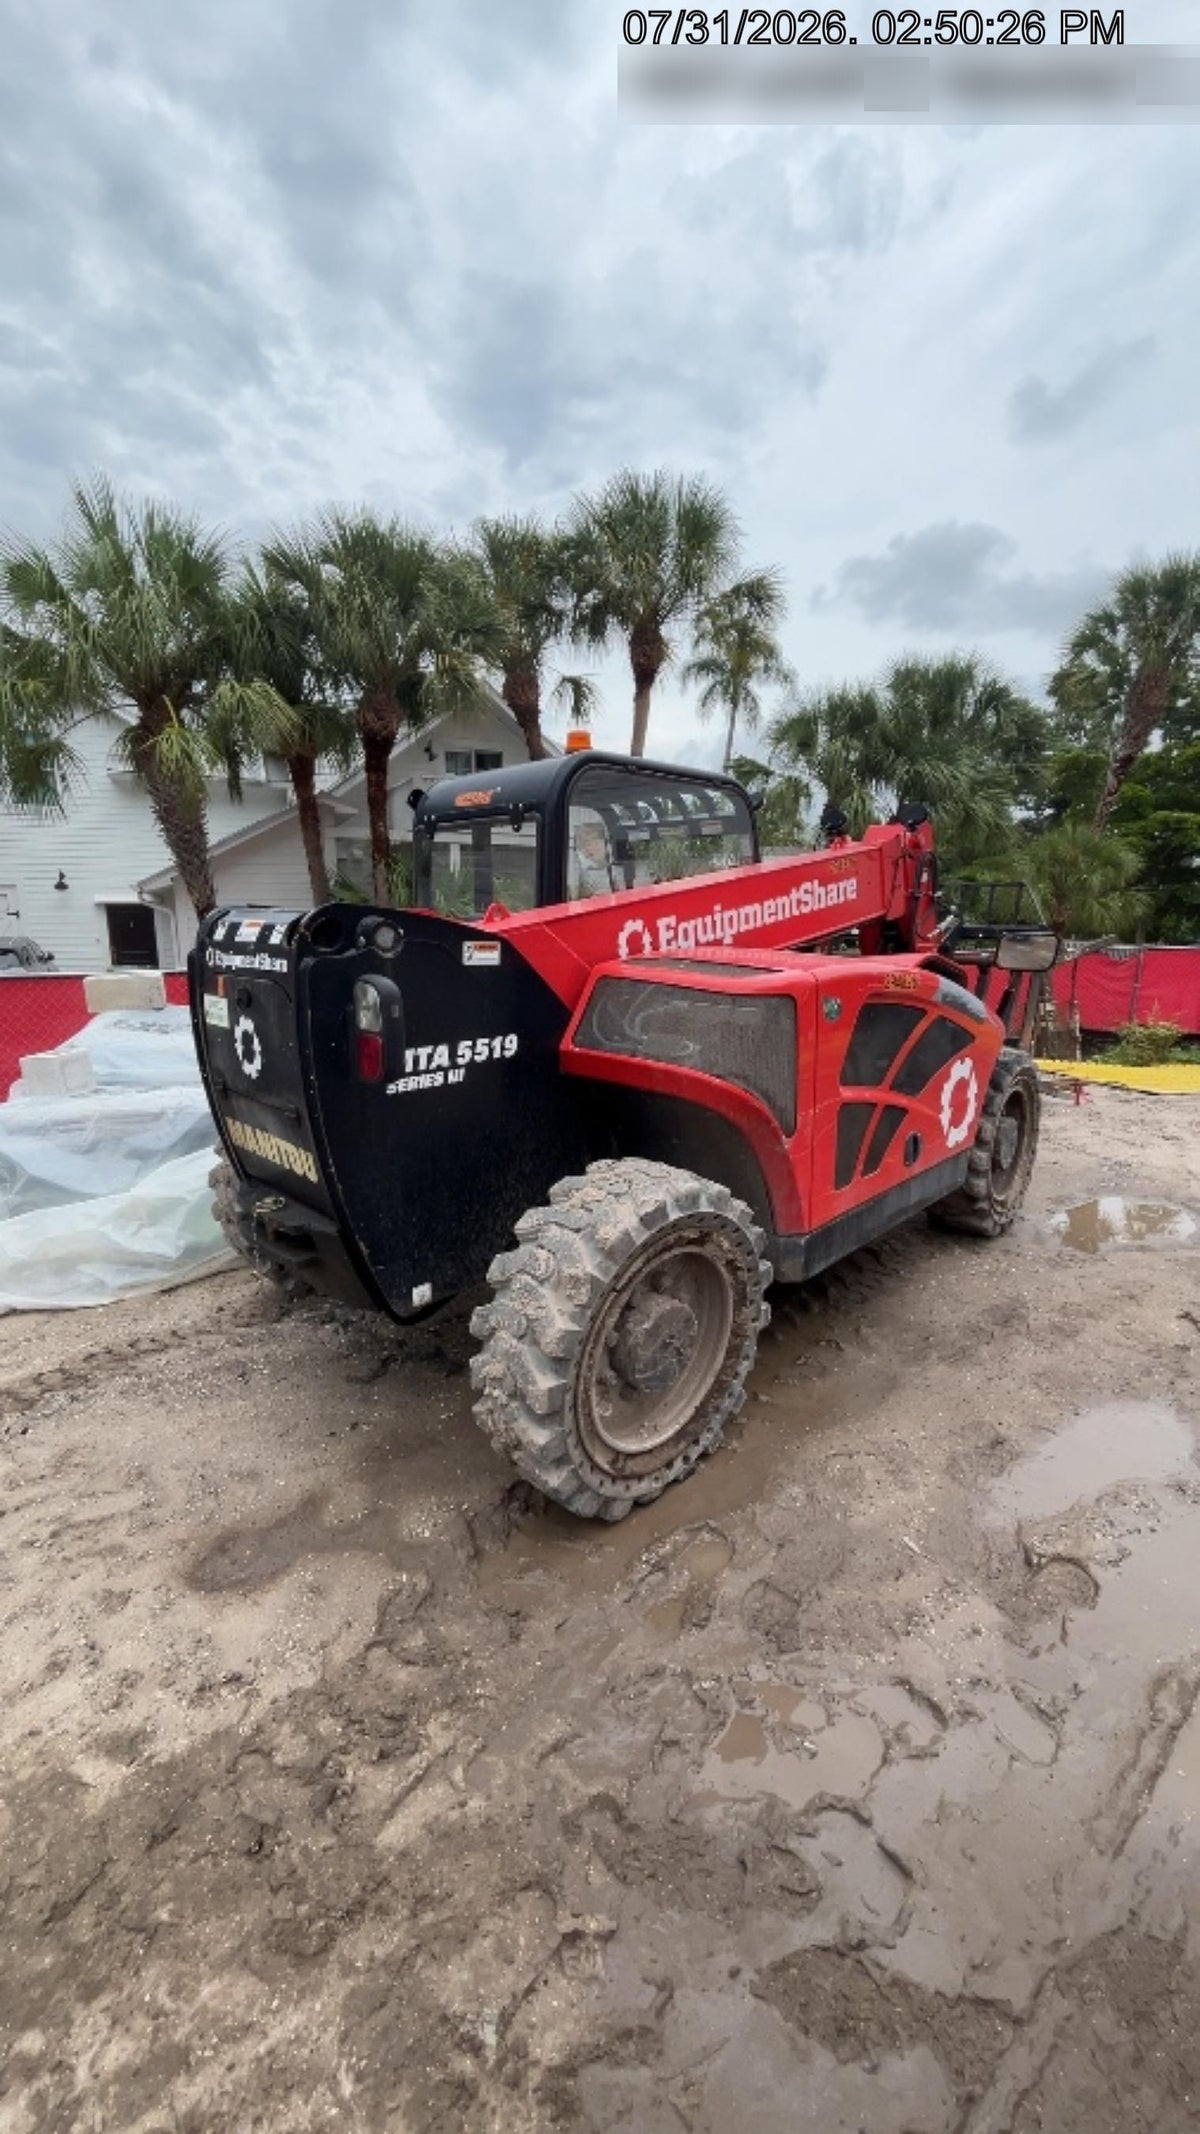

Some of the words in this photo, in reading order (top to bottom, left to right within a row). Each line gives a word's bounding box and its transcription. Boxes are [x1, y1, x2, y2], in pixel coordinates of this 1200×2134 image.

[657, 877, 857, 951] EquipmentShare
[456, 1033, 518, 1066] 5519
[386, 1071, 444, 1095] SERIES
[225, 1116, 319, 1185] MANITOU
